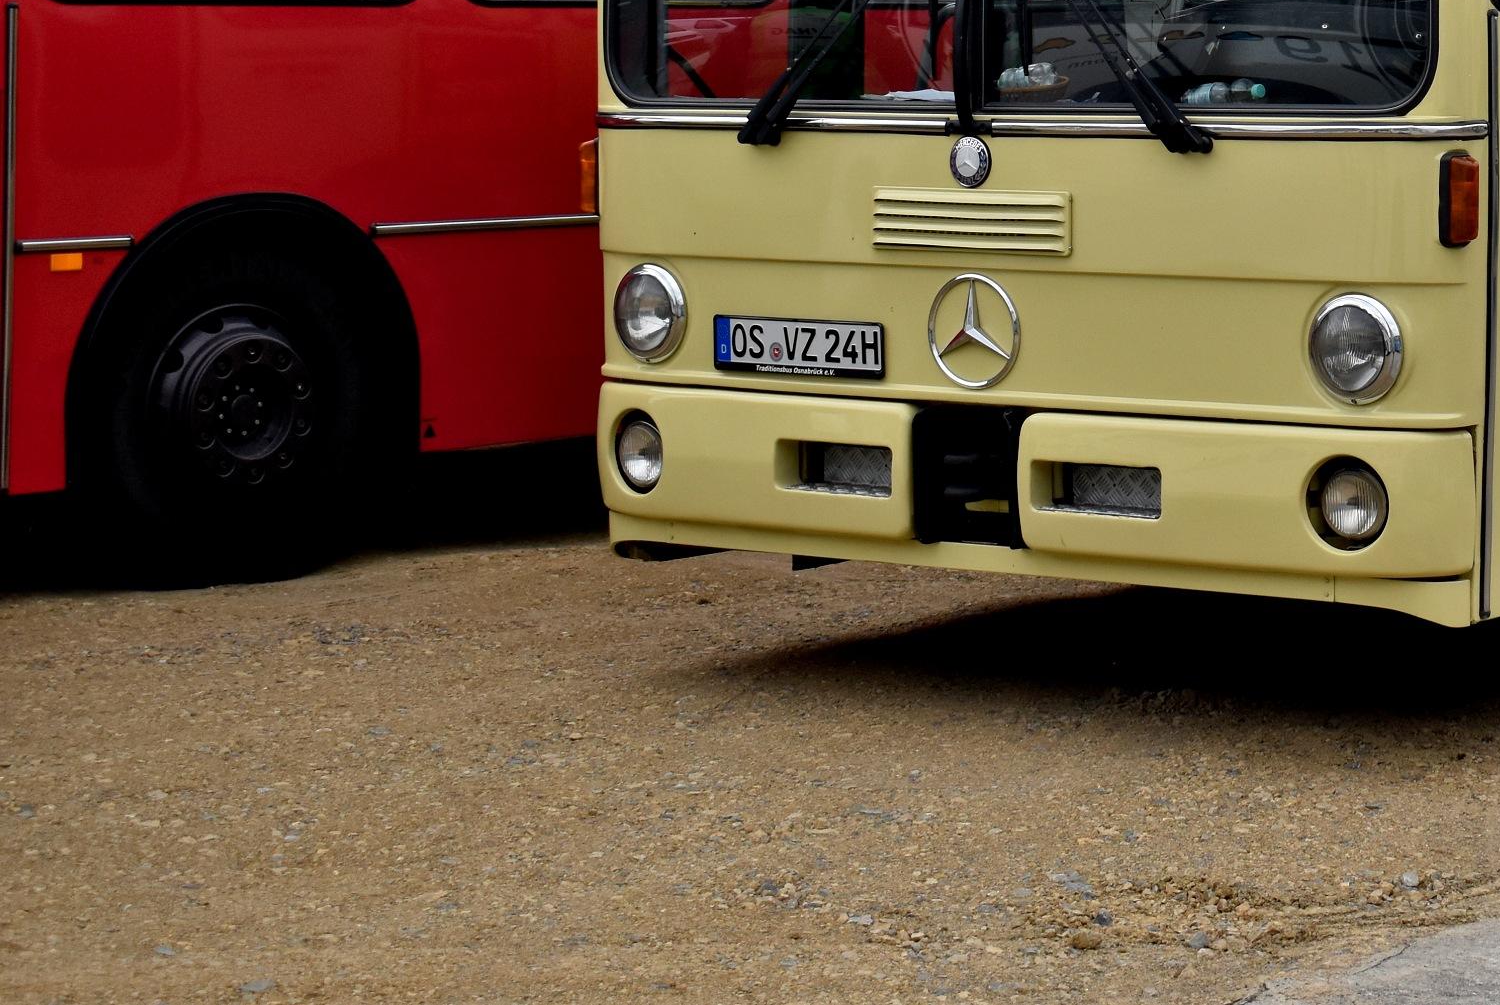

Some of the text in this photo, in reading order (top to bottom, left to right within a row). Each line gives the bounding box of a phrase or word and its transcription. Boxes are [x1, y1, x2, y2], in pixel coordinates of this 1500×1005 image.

[721, 344, 727, 354] D
[732, 323, 879, 365] OS VZ 24H
[755, 364, 792, 374] Traditionsbus
[793, 367, 823, 375] Osnabrück
